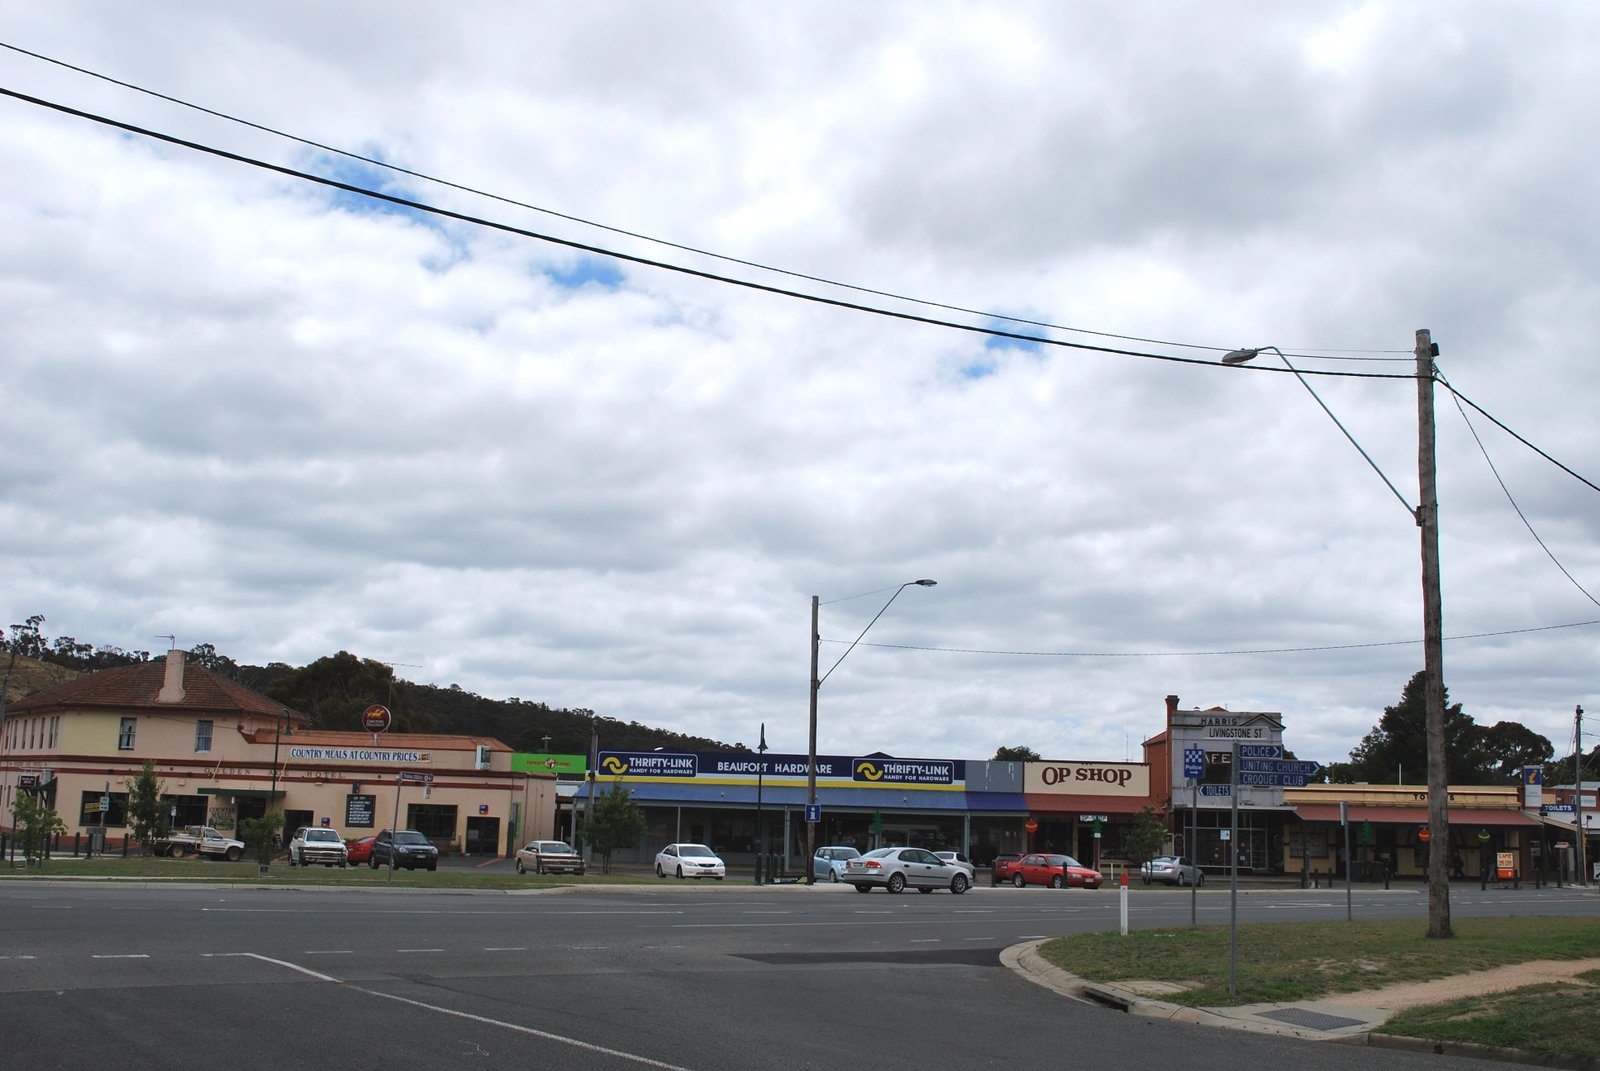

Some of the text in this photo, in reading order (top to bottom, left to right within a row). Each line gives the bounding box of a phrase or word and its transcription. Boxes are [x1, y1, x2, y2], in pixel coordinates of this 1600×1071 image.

[1201, 718, 1238, 726] HARRIS
[1209, 728, 1262, 738] LIVINGSTONE ST
[291, 748, 322, 759] COUNTRY
[325, 749, 347, 760] MEALS
[349, 751, 359, 760] AT
[359, 751, 391, 761] COUNTRY
[392, 752, 418, 762] PRICES
[1242, 747, 1270, 757] POLICE
[629, 757, 693, 768] THRIFTY-LINK
[1243, 761, 1310, 773] UNITING CHURCH
[883, 764, 949, 775] THRIFTY-LINK
[1041, 767, 1132, 787] OP SHOP
[1243, 774, 1304, 785] CROQUET CLUB
[1206, 786, 1230, 795] TOILETS
